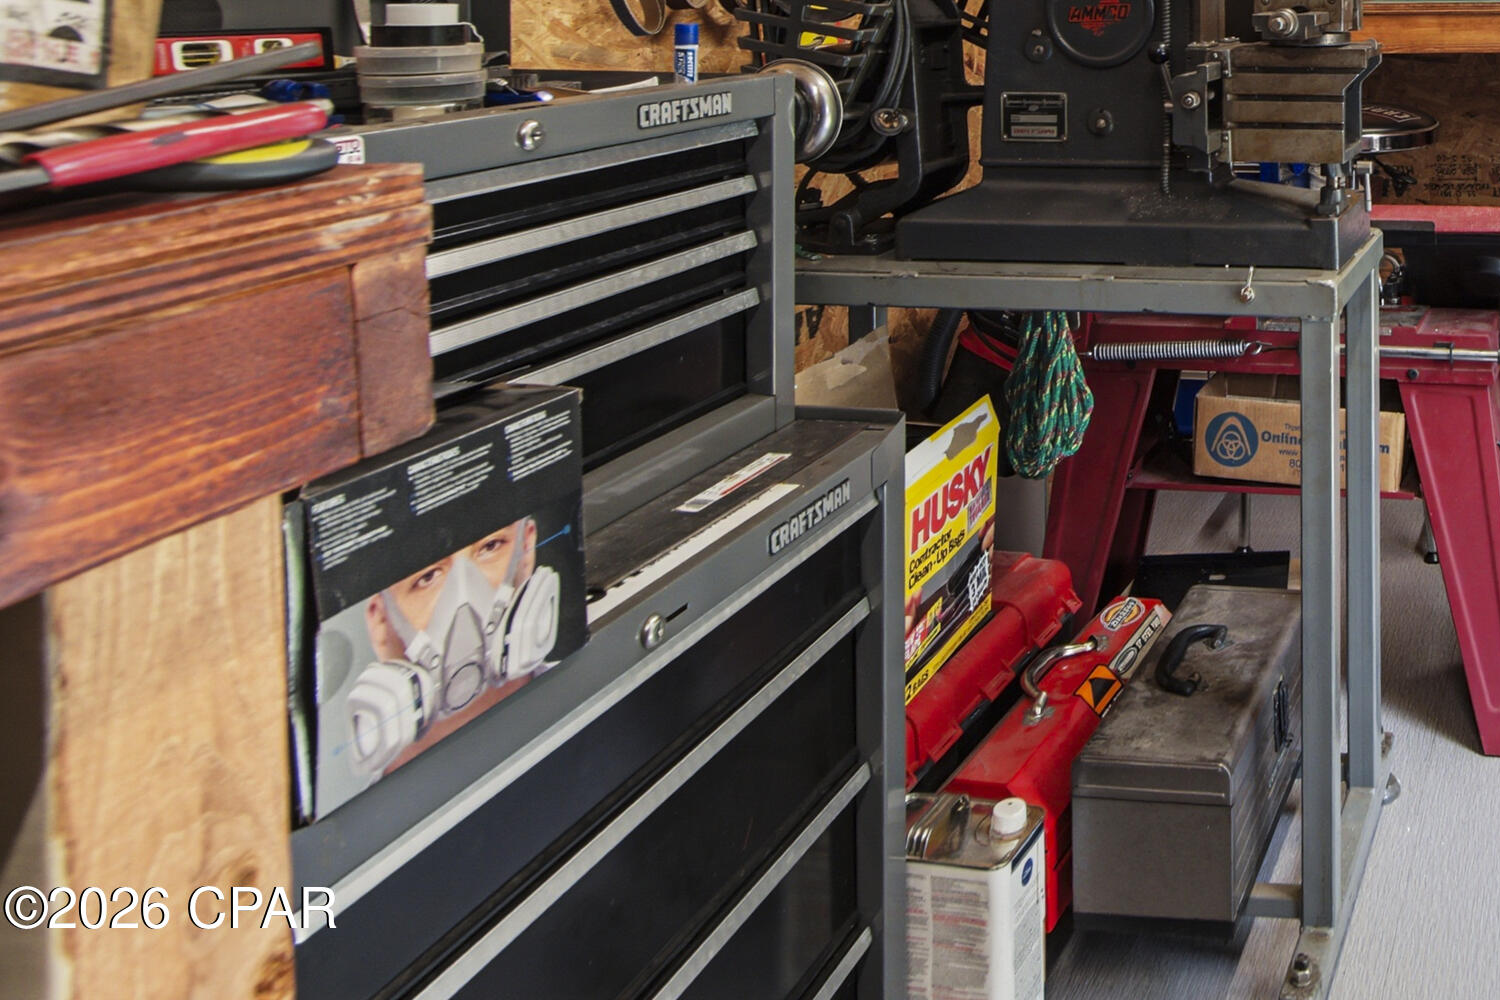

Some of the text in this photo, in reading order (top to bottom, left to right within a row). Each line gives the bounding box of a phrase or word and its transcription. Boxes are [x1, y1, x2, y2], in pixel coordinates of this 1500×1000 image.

[1068, 3, 1131, 23] AMMCO
[639, 92, 733, 129] CRAFTSMAN
[770, 479, 851, 555] CRAFTSMAN
[910, 445, 992, 554] HUSKY
[909, 528, 954, 574] Contractor
[949, 528, 967, 553] Bags
